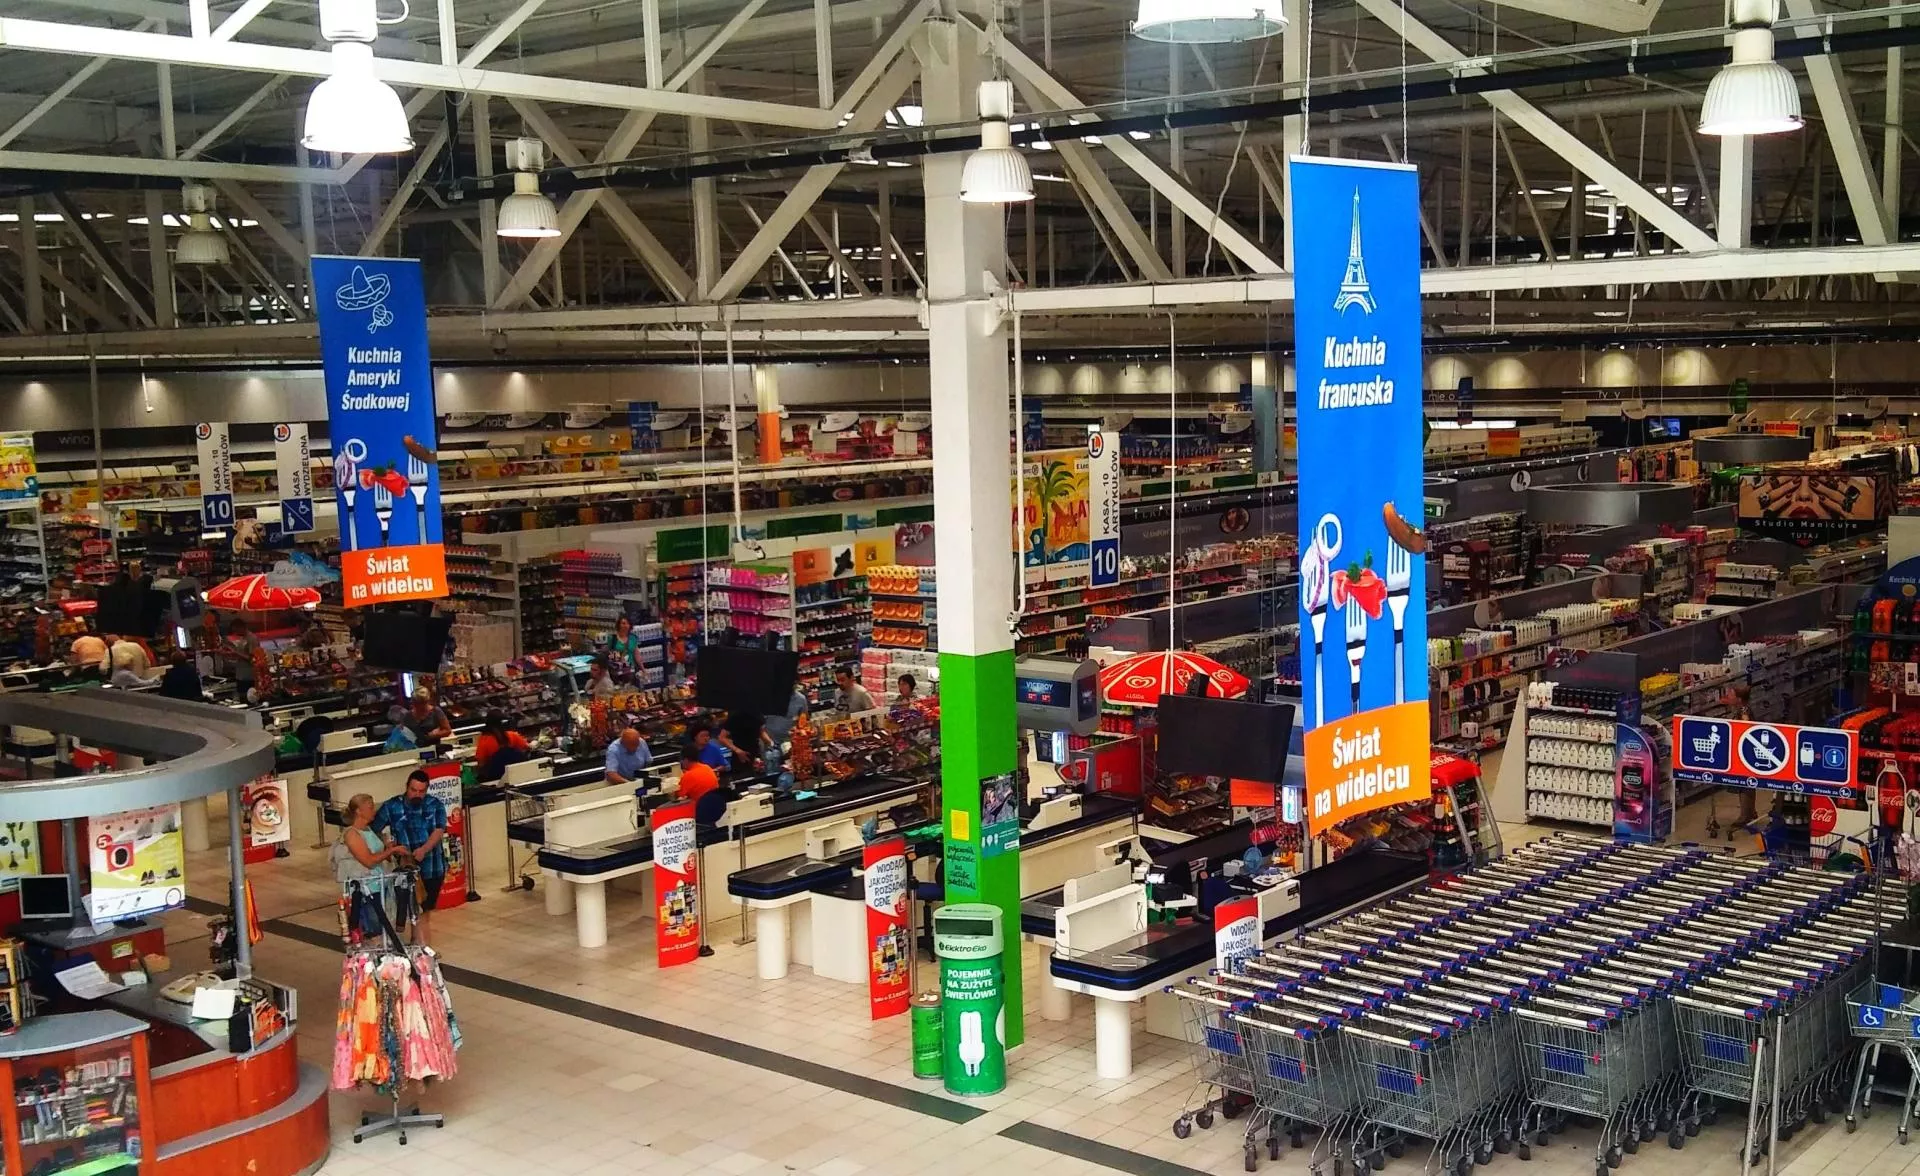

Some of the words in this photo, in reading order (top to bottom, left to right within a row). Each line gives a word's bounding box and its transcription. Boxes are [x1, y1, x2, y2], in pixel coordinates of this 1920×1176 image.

[348, 347, 402, 363] Kuchnia
[1324, 335, 1386, 368] Kuchnia
[347, 369, 401, 388] Ameryki
[341, 389, 410, 412] Środkowej
[1318, 374, 1394, 409] francuska
[220, 434, 231, 491] ARTYKUŁÓW
[300, 435, 311, 496] WYDZIELONA
[213, 466, 221, 492] KASA
[293, 470, 301, 496] KASA
[1103, 473, 1109, 485] 10
[207, 500, 231, 519] 10
[1755, 519, 1794, 527] Studio
[1801, 520, 1857, 529] Manicure
[367, 553, 410, 575] Świat
[1094, 547, 1116, 576] 10
[352, 583, 368, 599] na
[371, 576, 434, 596] widelcu
[1026, 681, 1053, 692] VICEROY
[1332, 727, 1381, 769] Świat
[1314, 789, 1332, 819] na
[1336, 763, 1410, 807] widelcu
[947, 967, 993, 978] POJEMNIK
[947, 980, 959, 988] NA
[960, 978, 993, 990] ZUŻYTE
[945, 987, 997, 1000] ŚWIETLÓWKI
